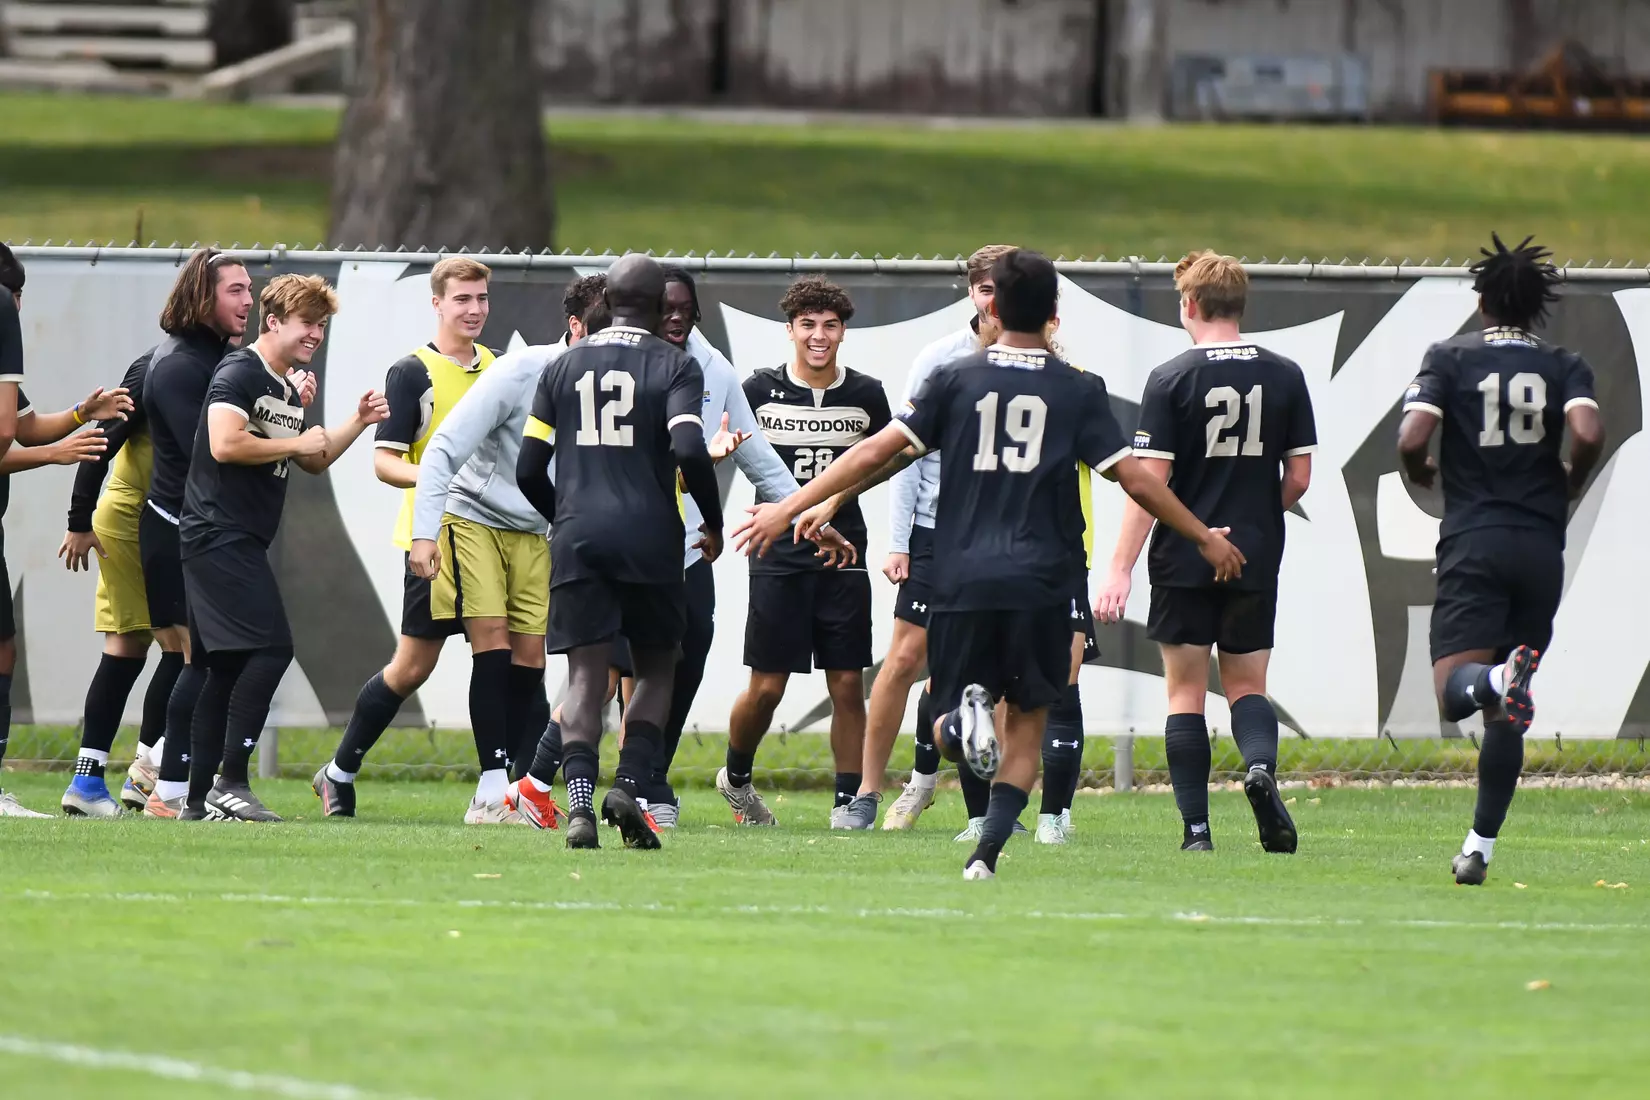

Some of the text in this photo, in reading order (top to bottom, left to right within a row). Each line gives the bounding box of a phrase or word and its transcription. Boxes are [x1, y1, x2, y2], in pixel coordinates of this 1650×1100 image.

[575, 370, 635, 447] 12
[761, 416, 864, 433] MASTODONS
[973, 391, 1048, 473] 19
[1205, 384, 1264, 458] 21
[1477, 372, 1547, 447] 18
[794, 448, 834, 479] 28
